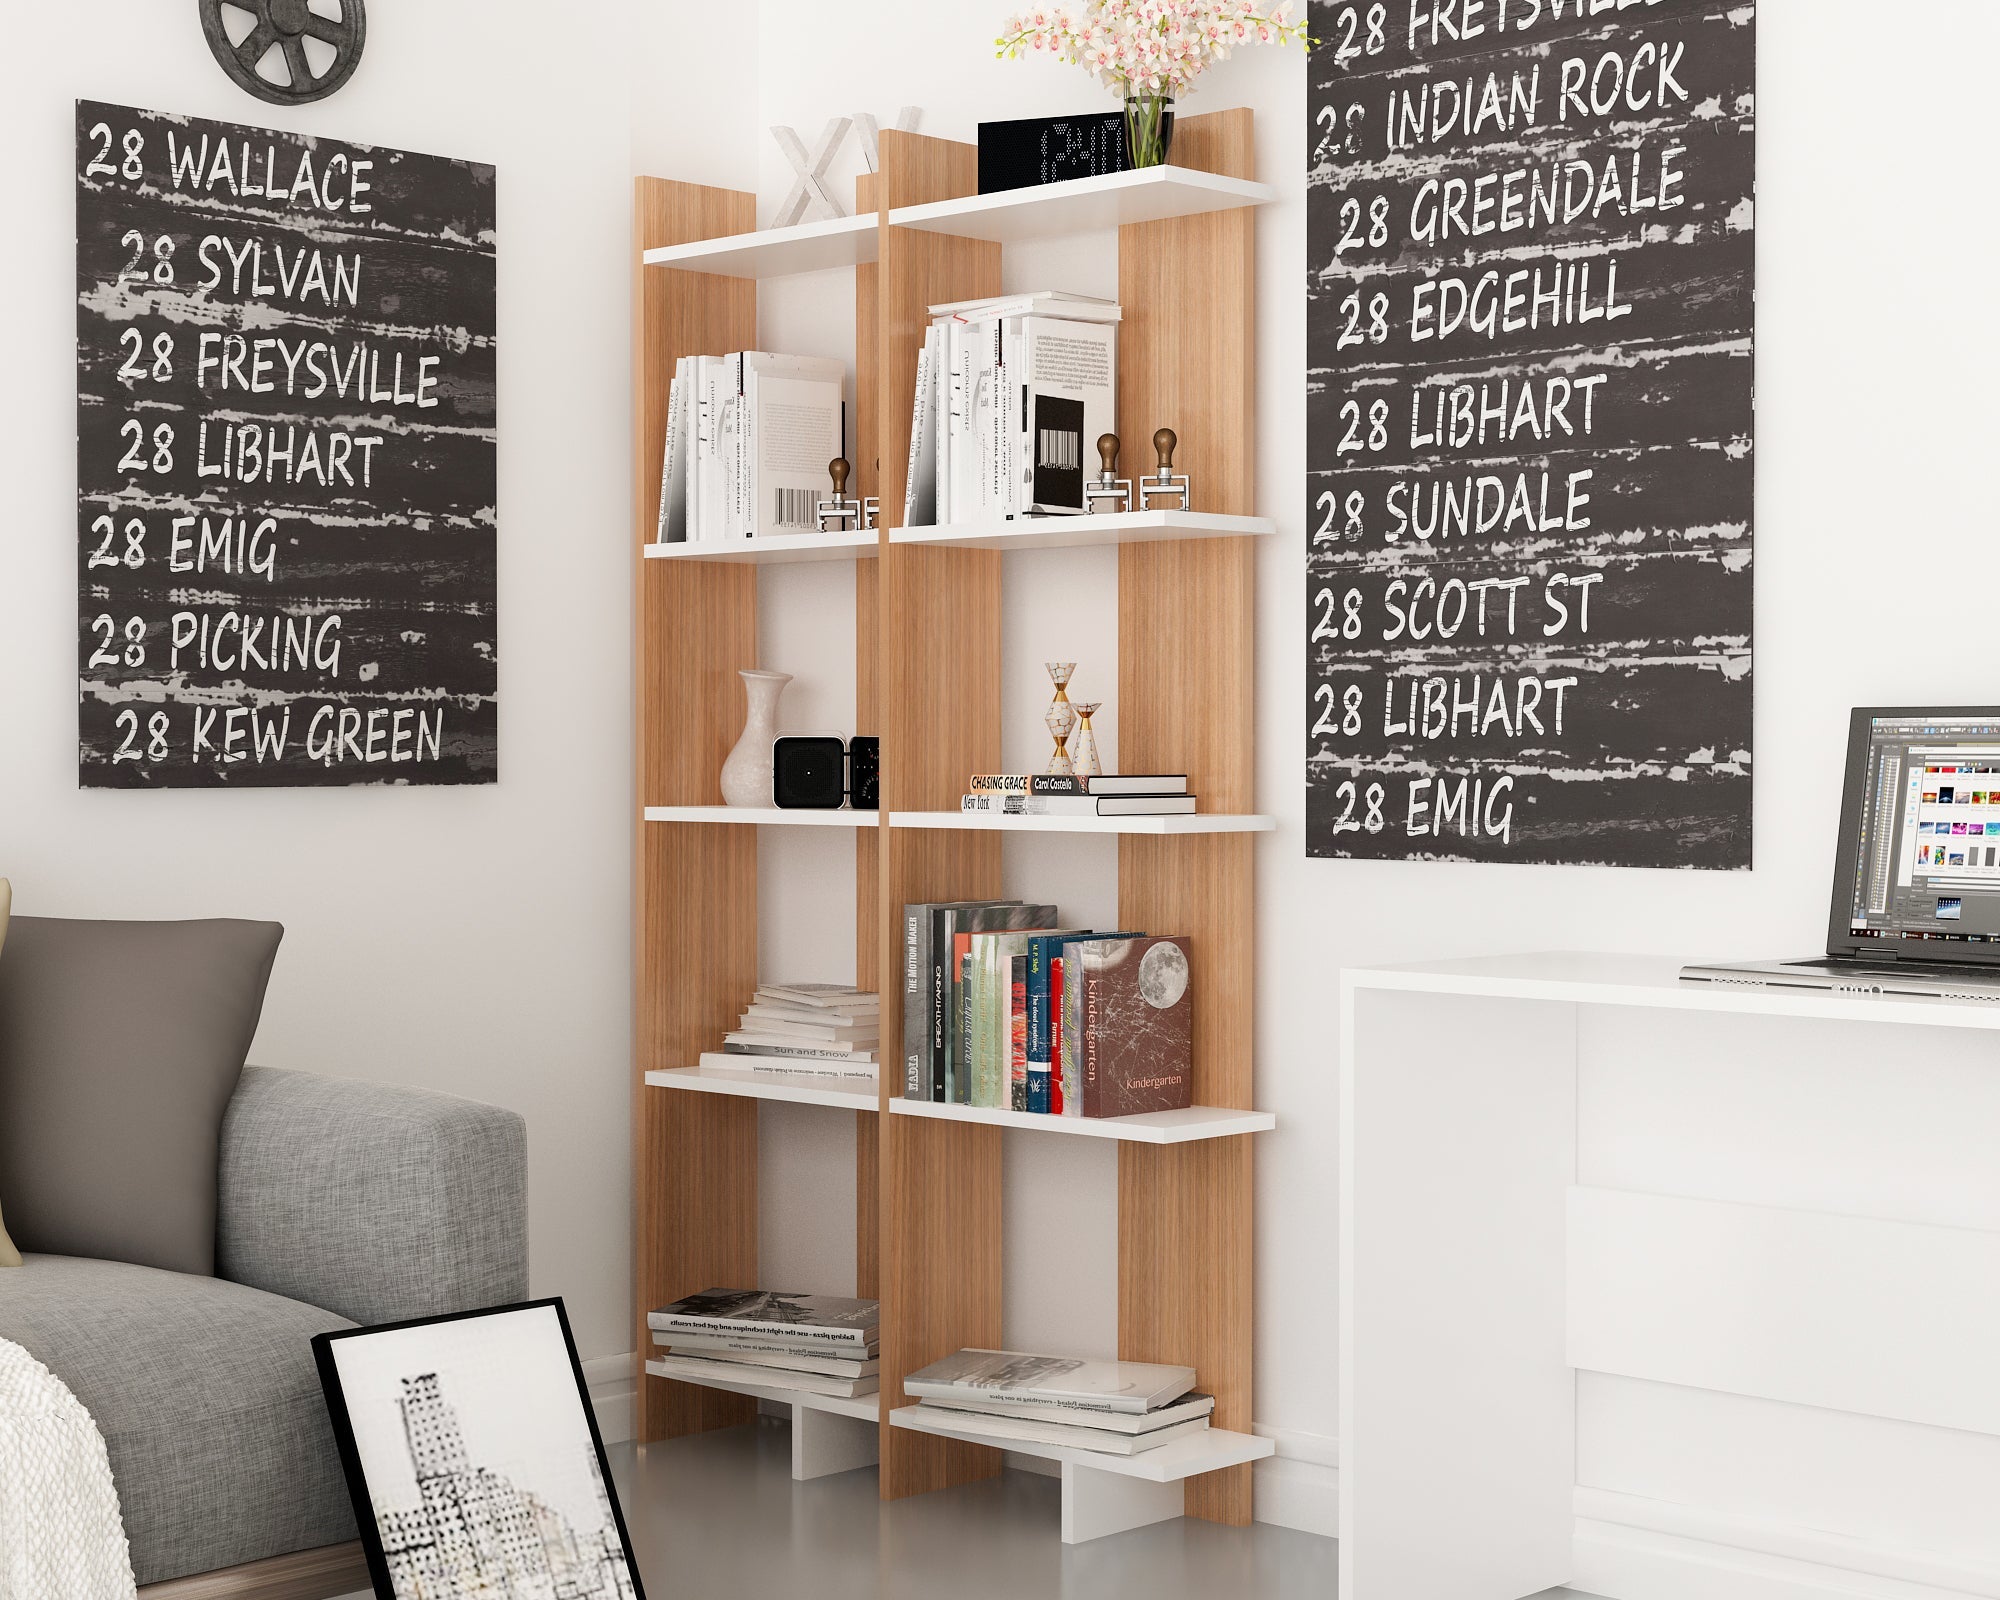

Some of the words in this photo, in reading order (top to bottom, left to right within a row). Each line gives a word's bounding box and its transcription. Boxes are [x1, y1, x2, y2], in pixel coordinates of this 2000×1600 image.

[1334, 2, 1386, 64] 28
[1408, 0, 1664, 50] FREYS
[1313, 101, 1366, 160] 28
[1386, 64, 1540, 147] INDIAN
[1559, 41, 1689, 121] ROCK
[86, 122, 145, 181] 28
[168, 130, 373, 214] WALLACE
[1337, 196, 1390, 254] 28
[1410, 146, 1687, 248] GREENDALE
[118, 229, 175, 288] 28
[198, 234, 361, 308] SYLVAN
[1337, 294, 1389, 351] 28
[1411, 260, 1632, 342] EDGEHILL
[117, 328, 173, 382] 28
[198, 331, 440, 408] FREYSVILLE
[917, 401, 926, 427] and
[1337, 399, 1389, 457] 28
[1410, 373, 1608, 450] LIBHART
[117, 420, 173, 472] 28
[198, 420, 383, 488] LIBHART
[1313, 490, 1364, 548] 28
[1385, 470, 1592, 543] SUNDALE
[88, 516, 146, 569] 28
[170, 518, 277, 581] EMIG
[1312, 586, 1362, 644] 28
[1383, 575, 1533, 641] SCOTT
[1544, 573, 1603, 636] ST
[88, 614, 146, 669] 28
[171, 611, 342, 678] PICKING
[113, 709, 169, 764] 28
[194, 708, 291, 764] KEW
[306, 706, 442, 768] GREEN
[1313, 684, 1363, 739] 28
[1384, 676, 1578, 739] LIBHART
[963, 796, 975, 809] New
[977, 796, 990, 809] York
[972, 776, 1002, 790] CHASING
[1004, 776, 1028, 790] GRACE
[1034, 777, 1050, 790] Carol
[1050, 777, 1072, 790] Costello
[1333, 779, 1384, 837] 28
[1407, 777, 1514, 844] EMIG
[907, 917, 917, 945] MAKER
[907, 946, 917, 977] MOTION
[907, 979, 917, 993] THE
[774, 1046, 794, 1054] Sun
[796, 1048, 817, 1056] and
[1086, 979, 1098, 1081] Kindergarten
[908, 1055, 919, 1092] NADIA
[1126, 1074, 1182, 1090] Kindergarten
